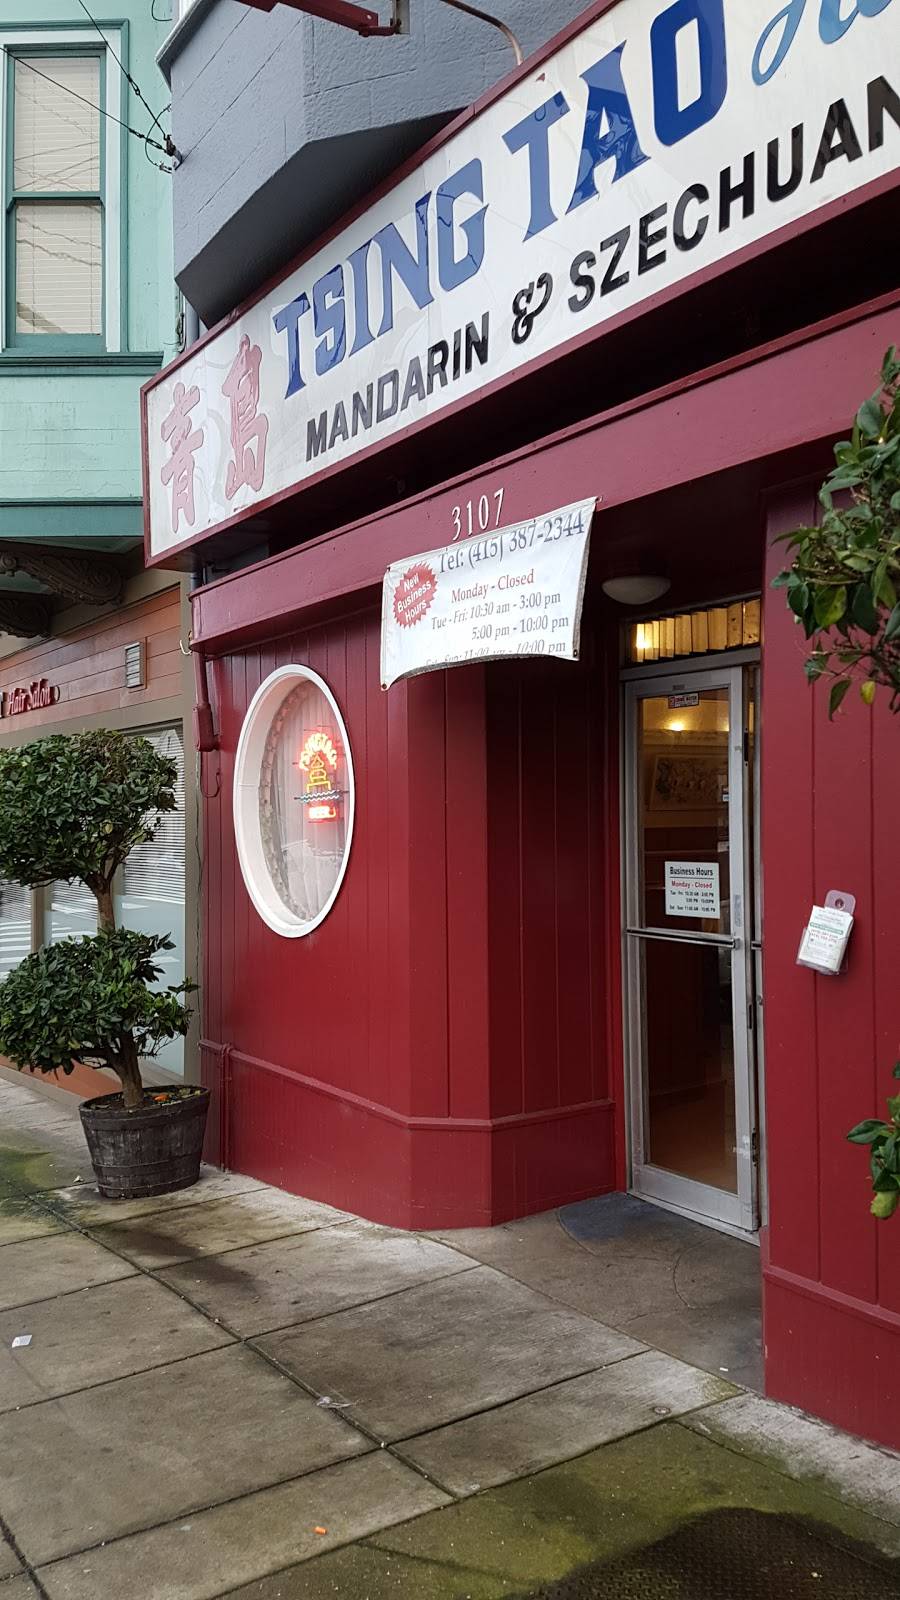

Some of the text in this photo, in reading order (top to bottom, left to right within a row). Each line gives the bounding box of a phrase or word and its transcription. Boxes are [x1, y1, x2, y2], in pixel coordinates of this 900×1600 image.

[272, 0, 728, 400] TSING TAO
[306, 75, 900, 462] MANDARIN & SZECHUAN
[452, 488, 505, 541] 3107
[438, 509, 585, 574] Tel: (415) 387-2344
[397, 581, 432, 612] Business
[404, 573, 420, 592] New
[451, 583, 489, 604] Monday
[497, 568, 535, 591] Closed
[405, 600, 427, 622] Hours
[431, 616, 446, 630] Tue
[453, 608, 468, 624] Fri:
[470, 601, 494, 620] 10:30
[496, 604, 510, 614] am
[519, 591, 542, 609] 3:00
[544, 592, 561, 609] pm
[471, 624, 492, 640] 5:00
[494, 626, 510, 640] pm
[520, 614, 548, 633] 10:00
[551, 616, 569, 632] pm
[548, 641, 566, 654] pm
[7, 678, 51, 715] Hair Salon
[669, 866, 714, 876] Business Hours
[671, 880, 690, 888] Monday
